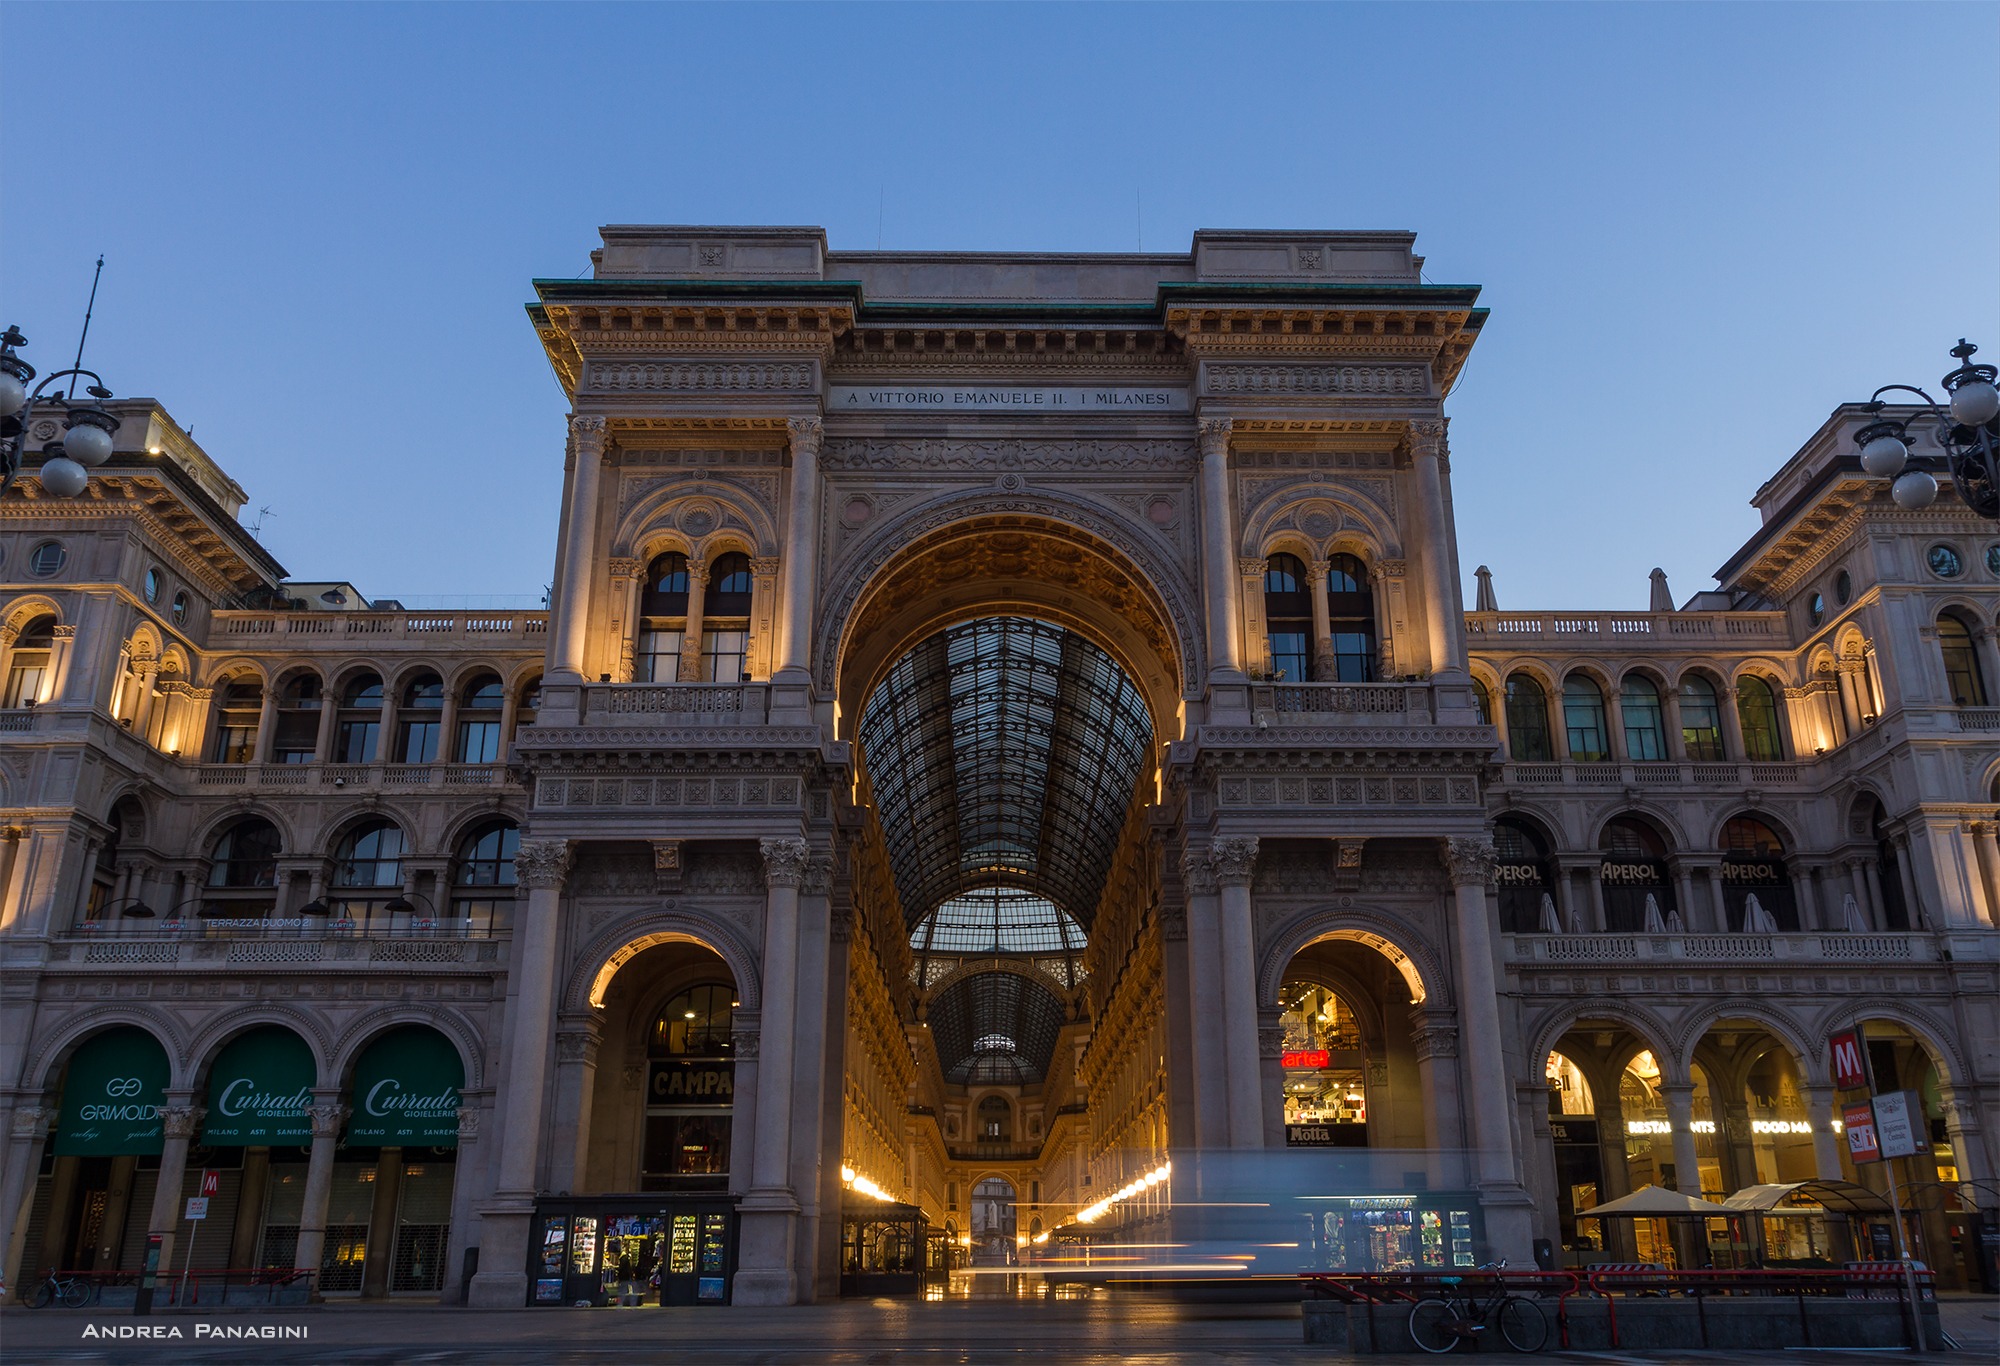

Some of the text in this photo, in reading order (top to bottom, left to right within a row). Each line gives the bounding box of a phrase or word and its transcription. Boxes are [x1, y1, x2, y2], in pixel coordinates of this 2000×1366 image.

[848, 392, 858, 403] A
[869, 392, 944, 404] VITTORIO
[954, 392, 1044, 404] EMANUELE
[1095, 393, 1170, 405] MILANESI
[1494, 865, 1542, 880] PEROL
[1601, 862, 1660, 880] APEROL
[1720, 862, 1778, 880] APEROL
[205, 918, 312, 928] TERRAZZA DUOMO 21
[1835, 1041, 1862, 1079] M
[654, 1071, 733, 1096] CAMPA
[219, 1078, 312, 1117] Currado
[365, 1078, 458, 1117] Currado
[404, 1110, 456, 1118] GIOIELLERIE
[1290, 1126, 1331, 1142] Motta
[1628, 1121, 1716, 1134] RESTAUNTS
[1752, 1121, 1843, 1134] FOOD MAT
[205, 1176, 217, 1192] M
